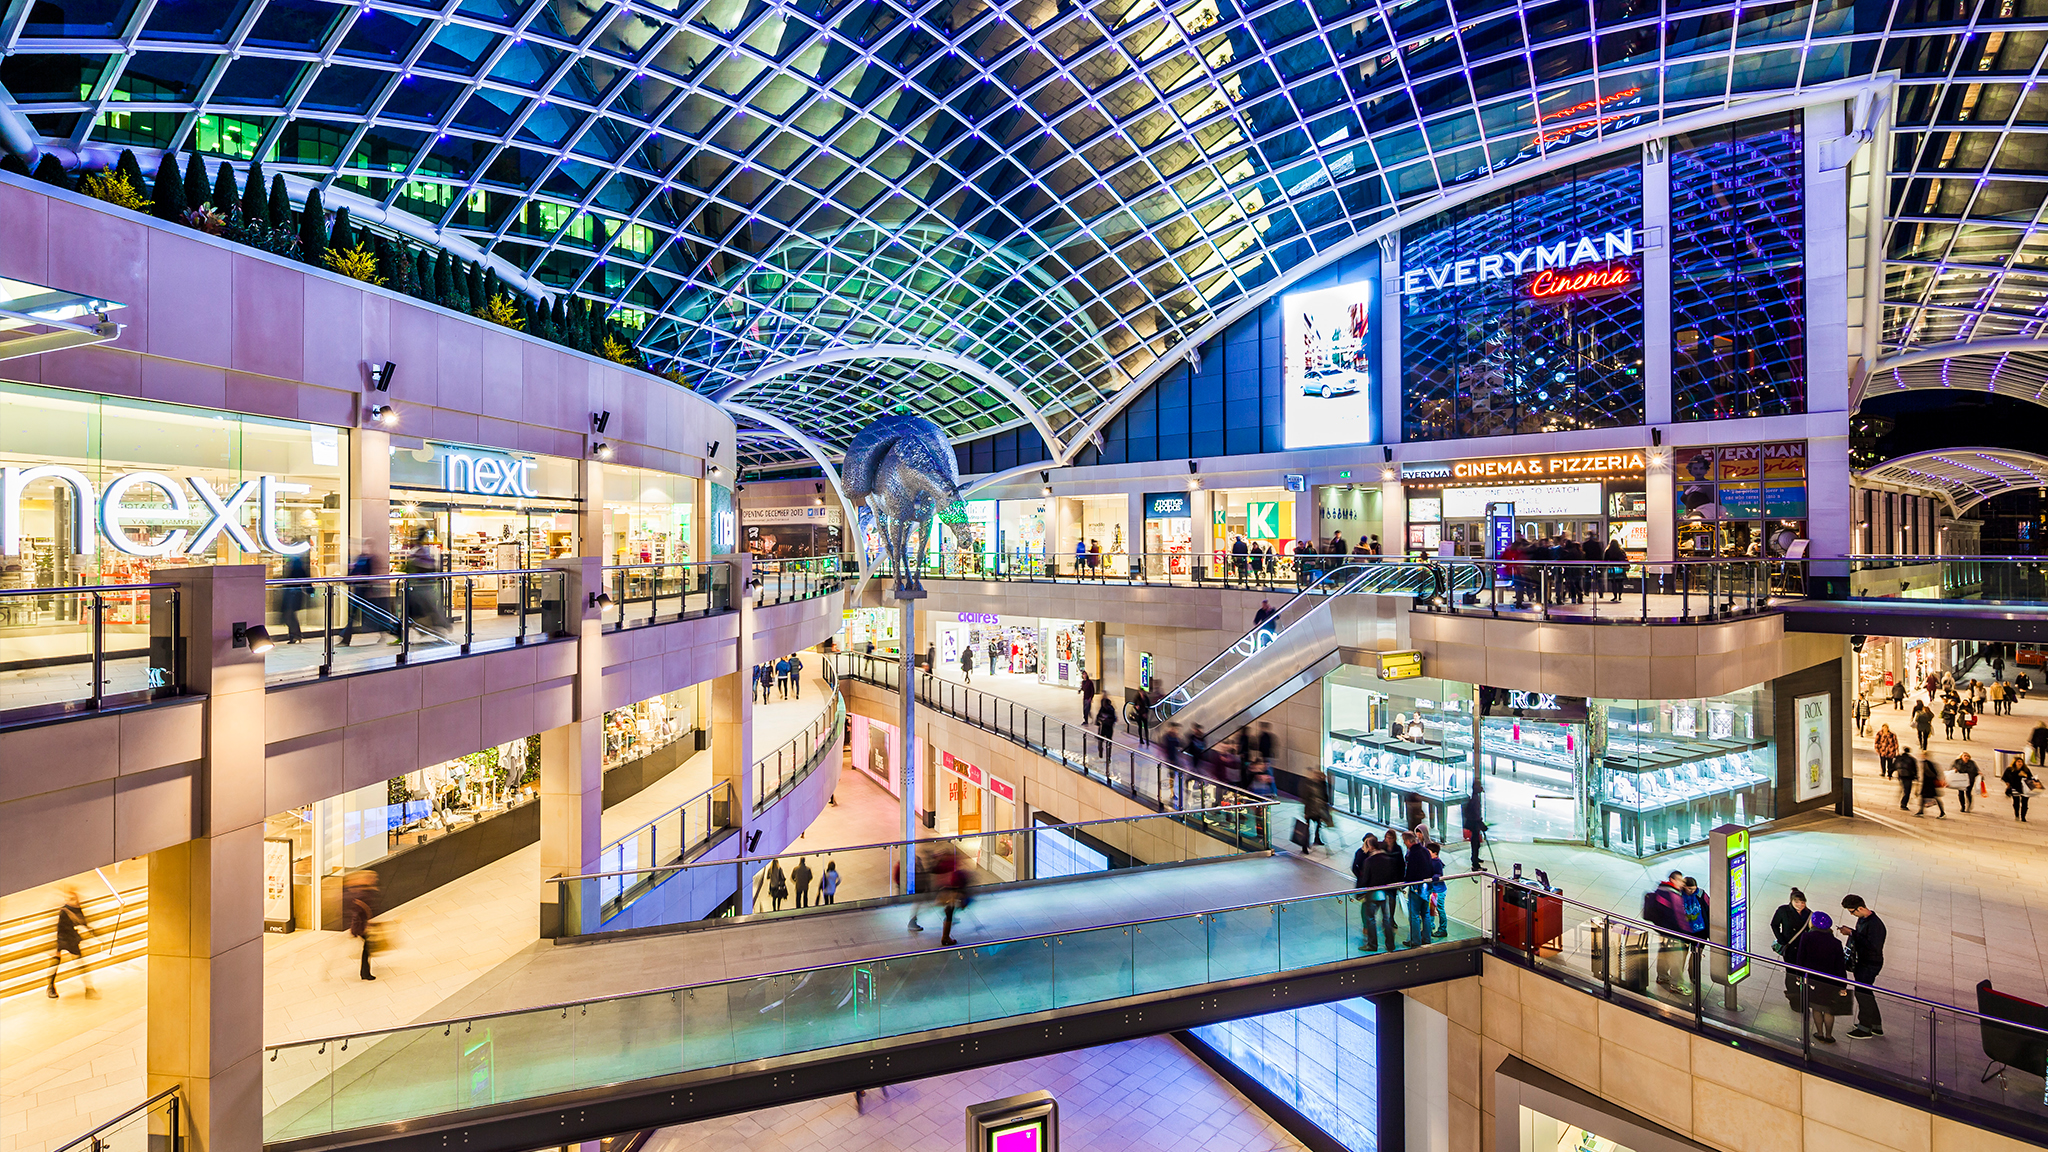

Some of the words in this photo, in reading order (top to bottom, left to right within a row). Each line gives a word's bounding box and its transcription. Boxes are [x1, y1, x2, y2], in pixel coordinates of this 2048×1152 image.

[1404, 227, 1634, 296] EVERYMAN
[1533, 267, 1631, 298] Cinema
[1701, 444, 1803, 461] EVERYMAN
[1453, 460, 1527, 478] CINEMA
[1528, 460, 1543, 474] &
[1549, 454, 1646, 473] PIZZERIA
[1721, 458, 1804, 479] Pizzeria
[445, 454, 539, 498] next
[1546, 486, 1580, 494] WATCH
[0, 464, 313, 557] next
[743, 509, 765, 518] OPENING
[765, 508, 790, 517] DECEMBER
[790, 507, 804, 517] 2013
[1159, 504, 1182, 513] papas
[1508, 689, 1559, 710] ROX
[1804, 701, 1823, 719] ROX
[949, 780, 967, 792] LOE
[949, 789, 967, 801] PIK
